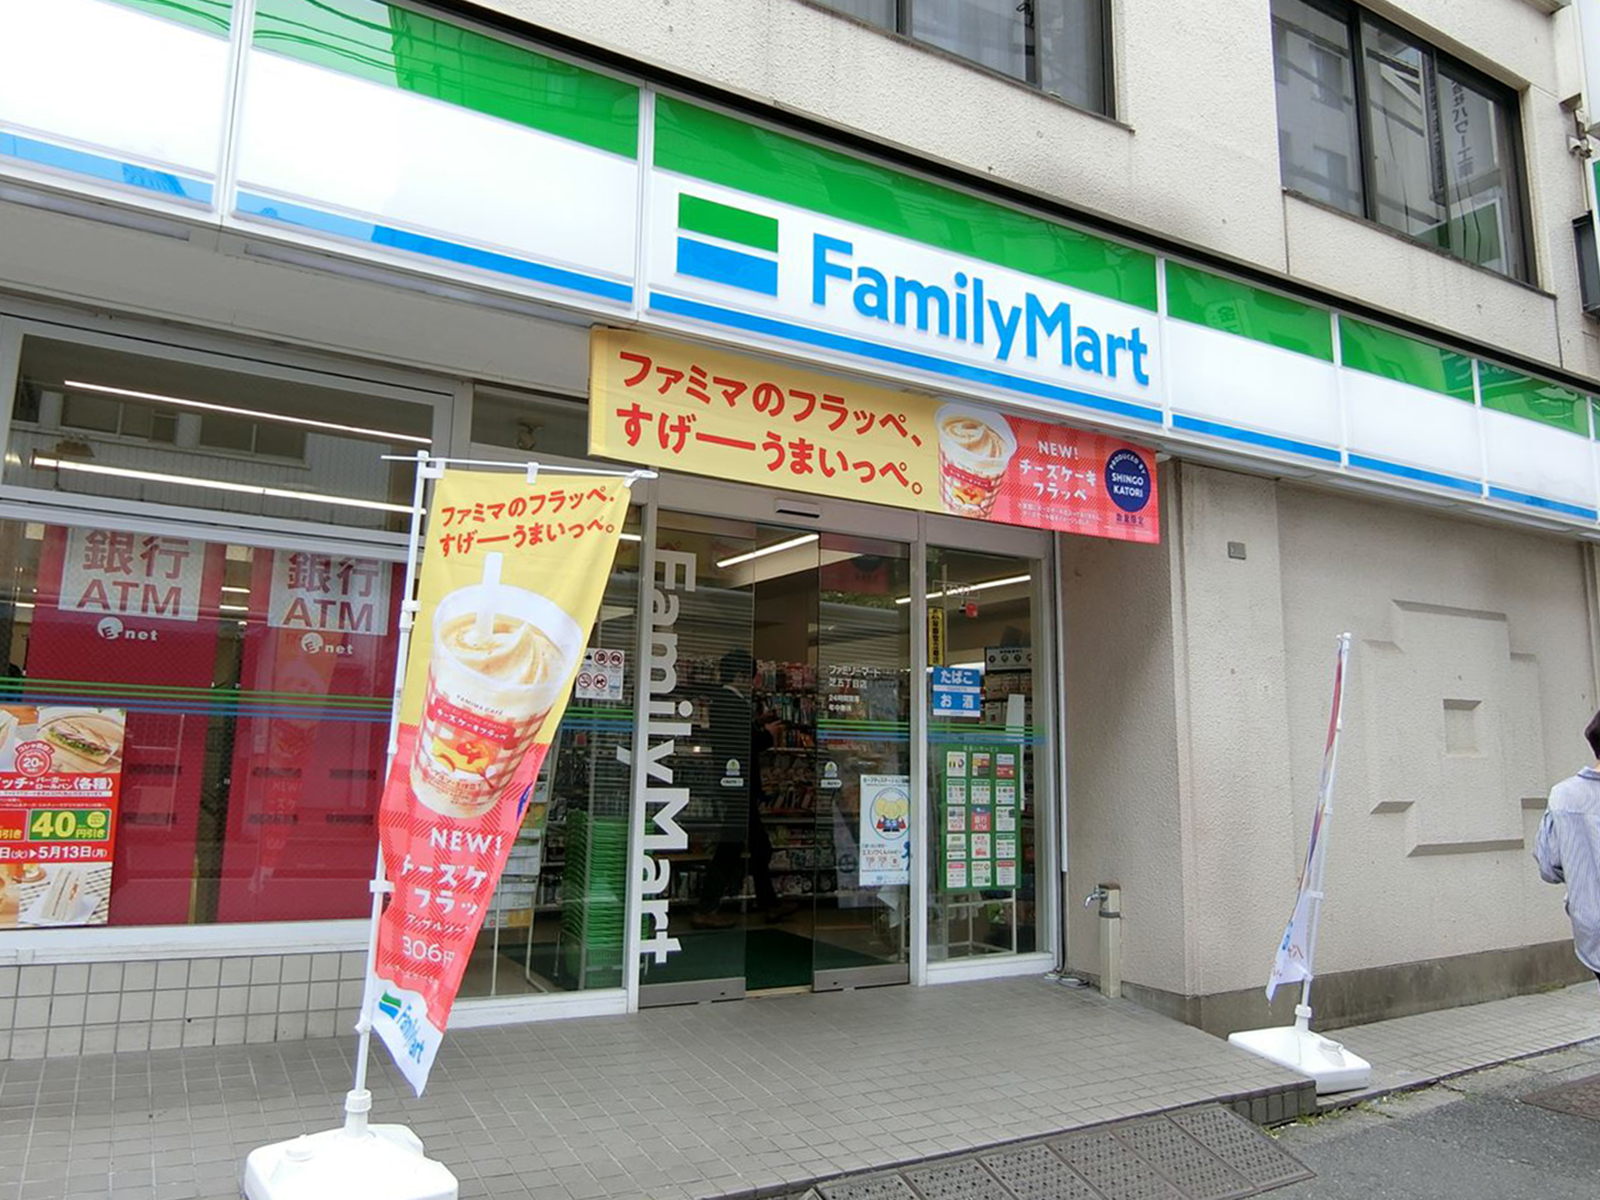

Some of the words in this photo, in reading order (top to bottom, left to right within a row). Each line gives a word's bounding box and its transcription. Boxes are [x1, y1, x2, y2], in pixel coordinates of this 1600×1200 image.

[812, 232, 1150, 386] FamilyMart
[1037, 441, 1079, 460] NEW!
[1109, 454, 1140, 471] PRODUCED
[1018, 458, 1097, 487] チーズケーキ
[1111, 472, 1144, 487] SHINGO
[1033, 482, 1087, 501] フラッペ
[1113, 485, 1144, 498] KATORI
[83, 529, 190, 579] 銀行
[288, 550, 379, 600] 銀行
[76, 579, 182, 617] ATM
[280, 596, 375, 632] ATM
[829, 665, 881, 678] ファミリーマート
[940, 669, 974, 685] たばこ
[622, 549, 698, 965] FamilyMart
[429, 826, 502, 856] NEW!
[413, 887, 479, 916] フラッ
